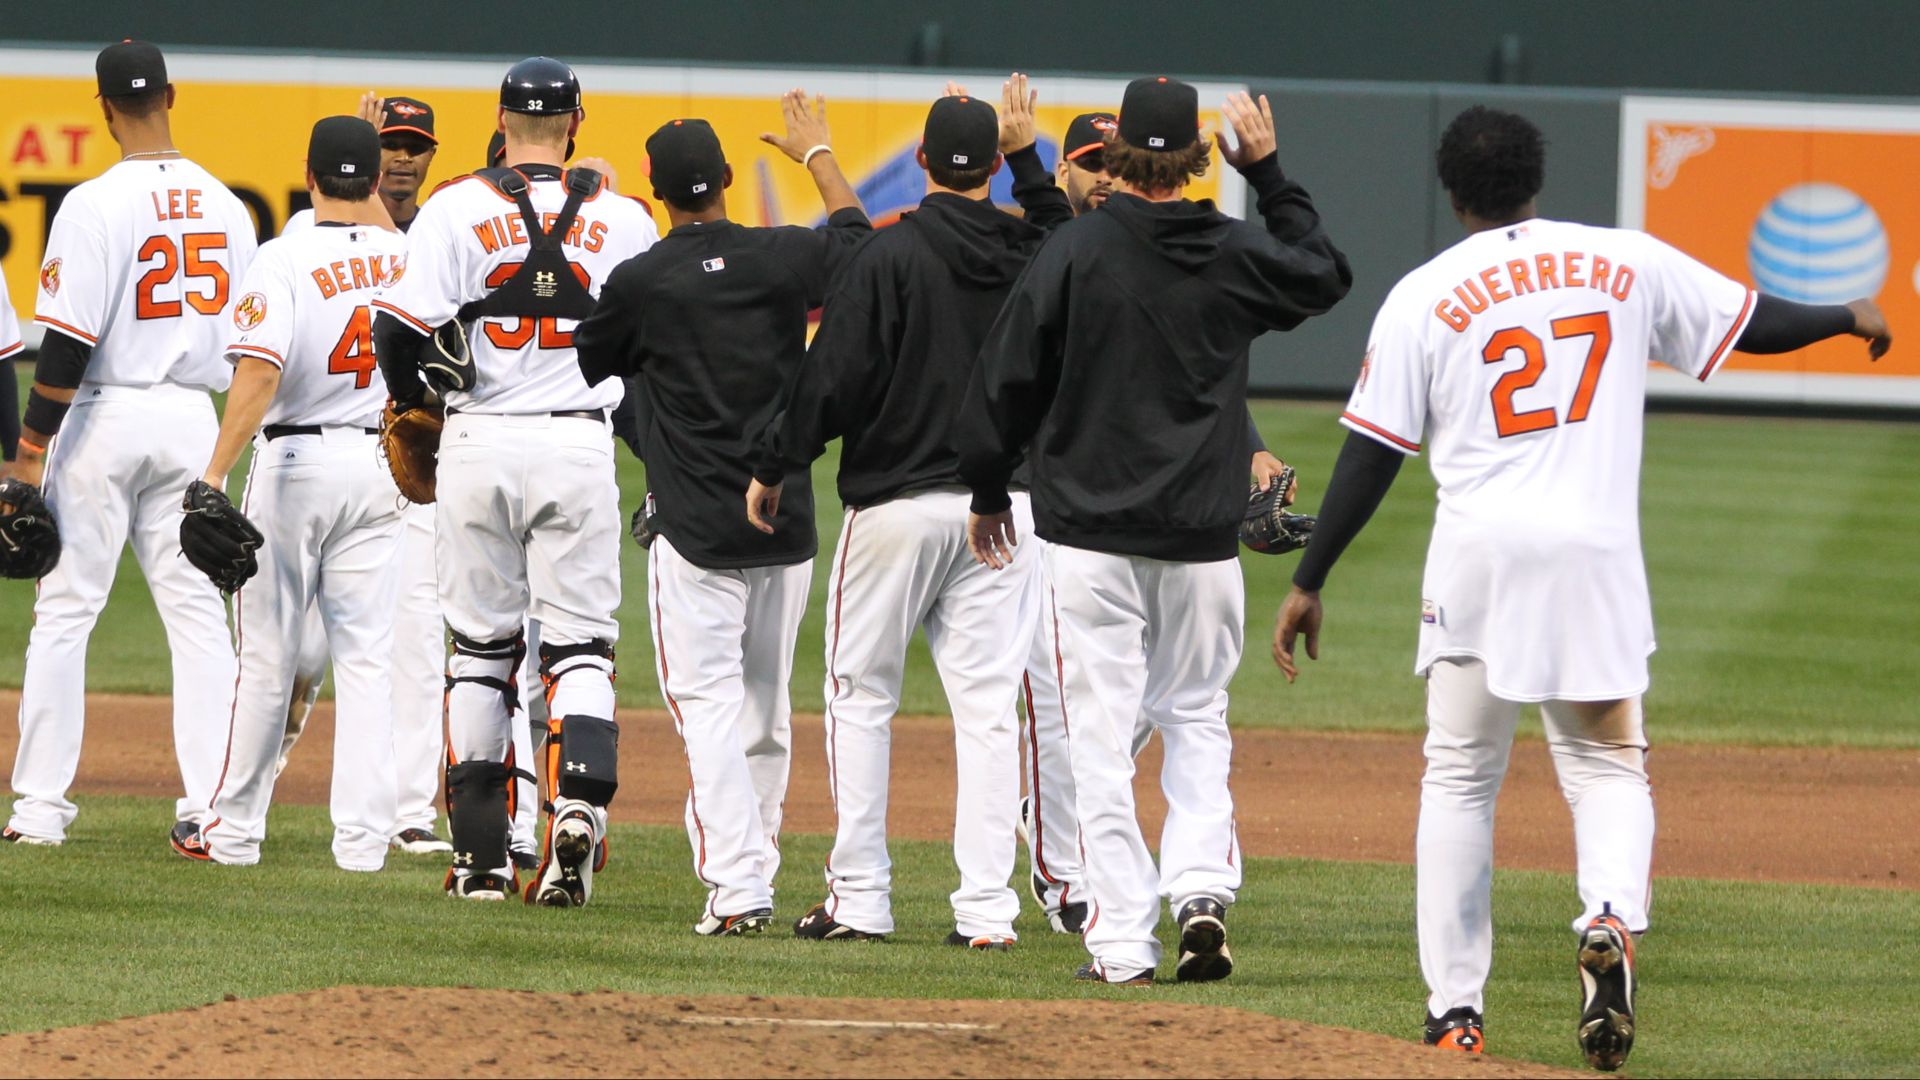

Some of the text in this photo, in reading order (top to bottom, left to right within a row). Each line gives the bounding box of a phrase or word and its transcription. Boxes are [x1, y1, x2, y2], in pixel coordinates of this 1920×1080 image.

[528, 99, 543, 110] 32
[12, 123, 92, 167] AT
[152, 189, 203, 222] LEE
[472, 212, 608, 254] WIEERS
[136, 232, 230, 320] 25
[1435, 252, 1635, 332] GUERRERO
[1481, 311, 1612, 438] 27
